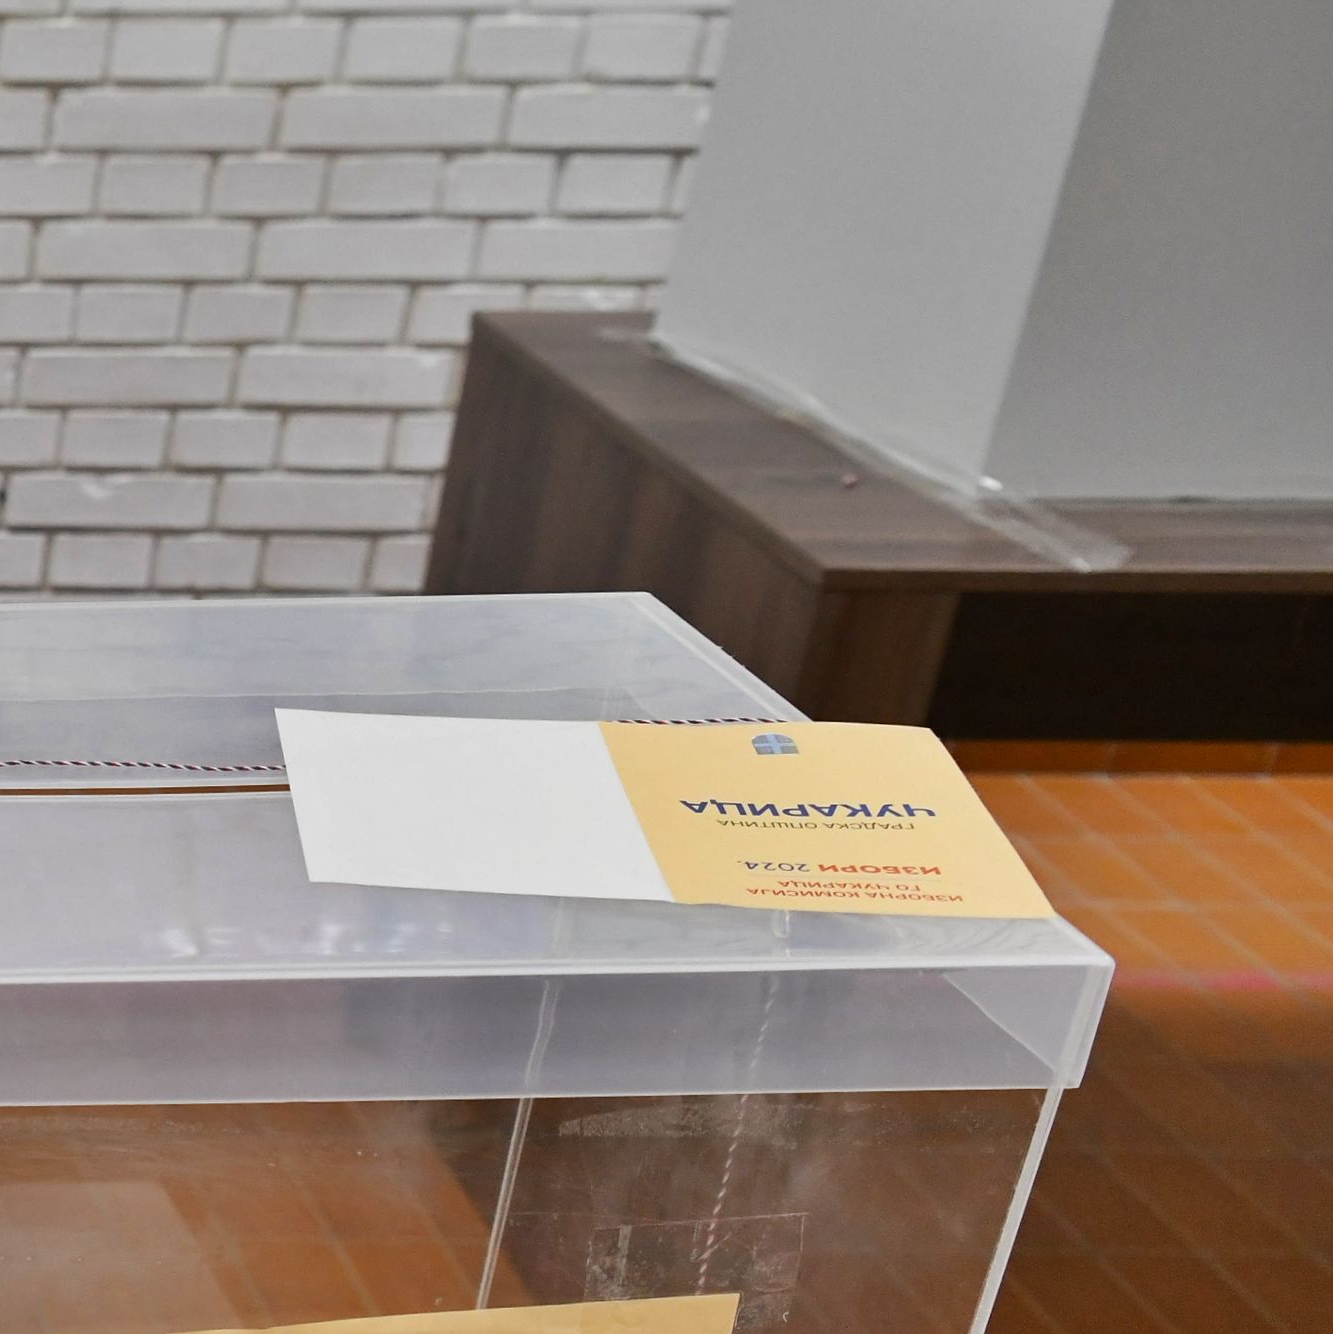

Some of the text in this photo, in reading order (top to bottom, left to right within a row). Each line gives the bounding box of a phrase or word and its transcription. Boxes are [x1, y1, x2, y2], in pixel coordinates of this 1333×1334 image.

[679, 799, 937, 818] ЧУКАРИЦА
[716, 818, 916, 831] ГРАДСКА ОПШТИНА
[736, 859, 942, 876] ИЗБОРИ 2024.
[776, 879, 922, 892] ГО ЧУКАРИЦА
[744, 887, 964, 903] ИЗБОРНА КОМИСИЈА
